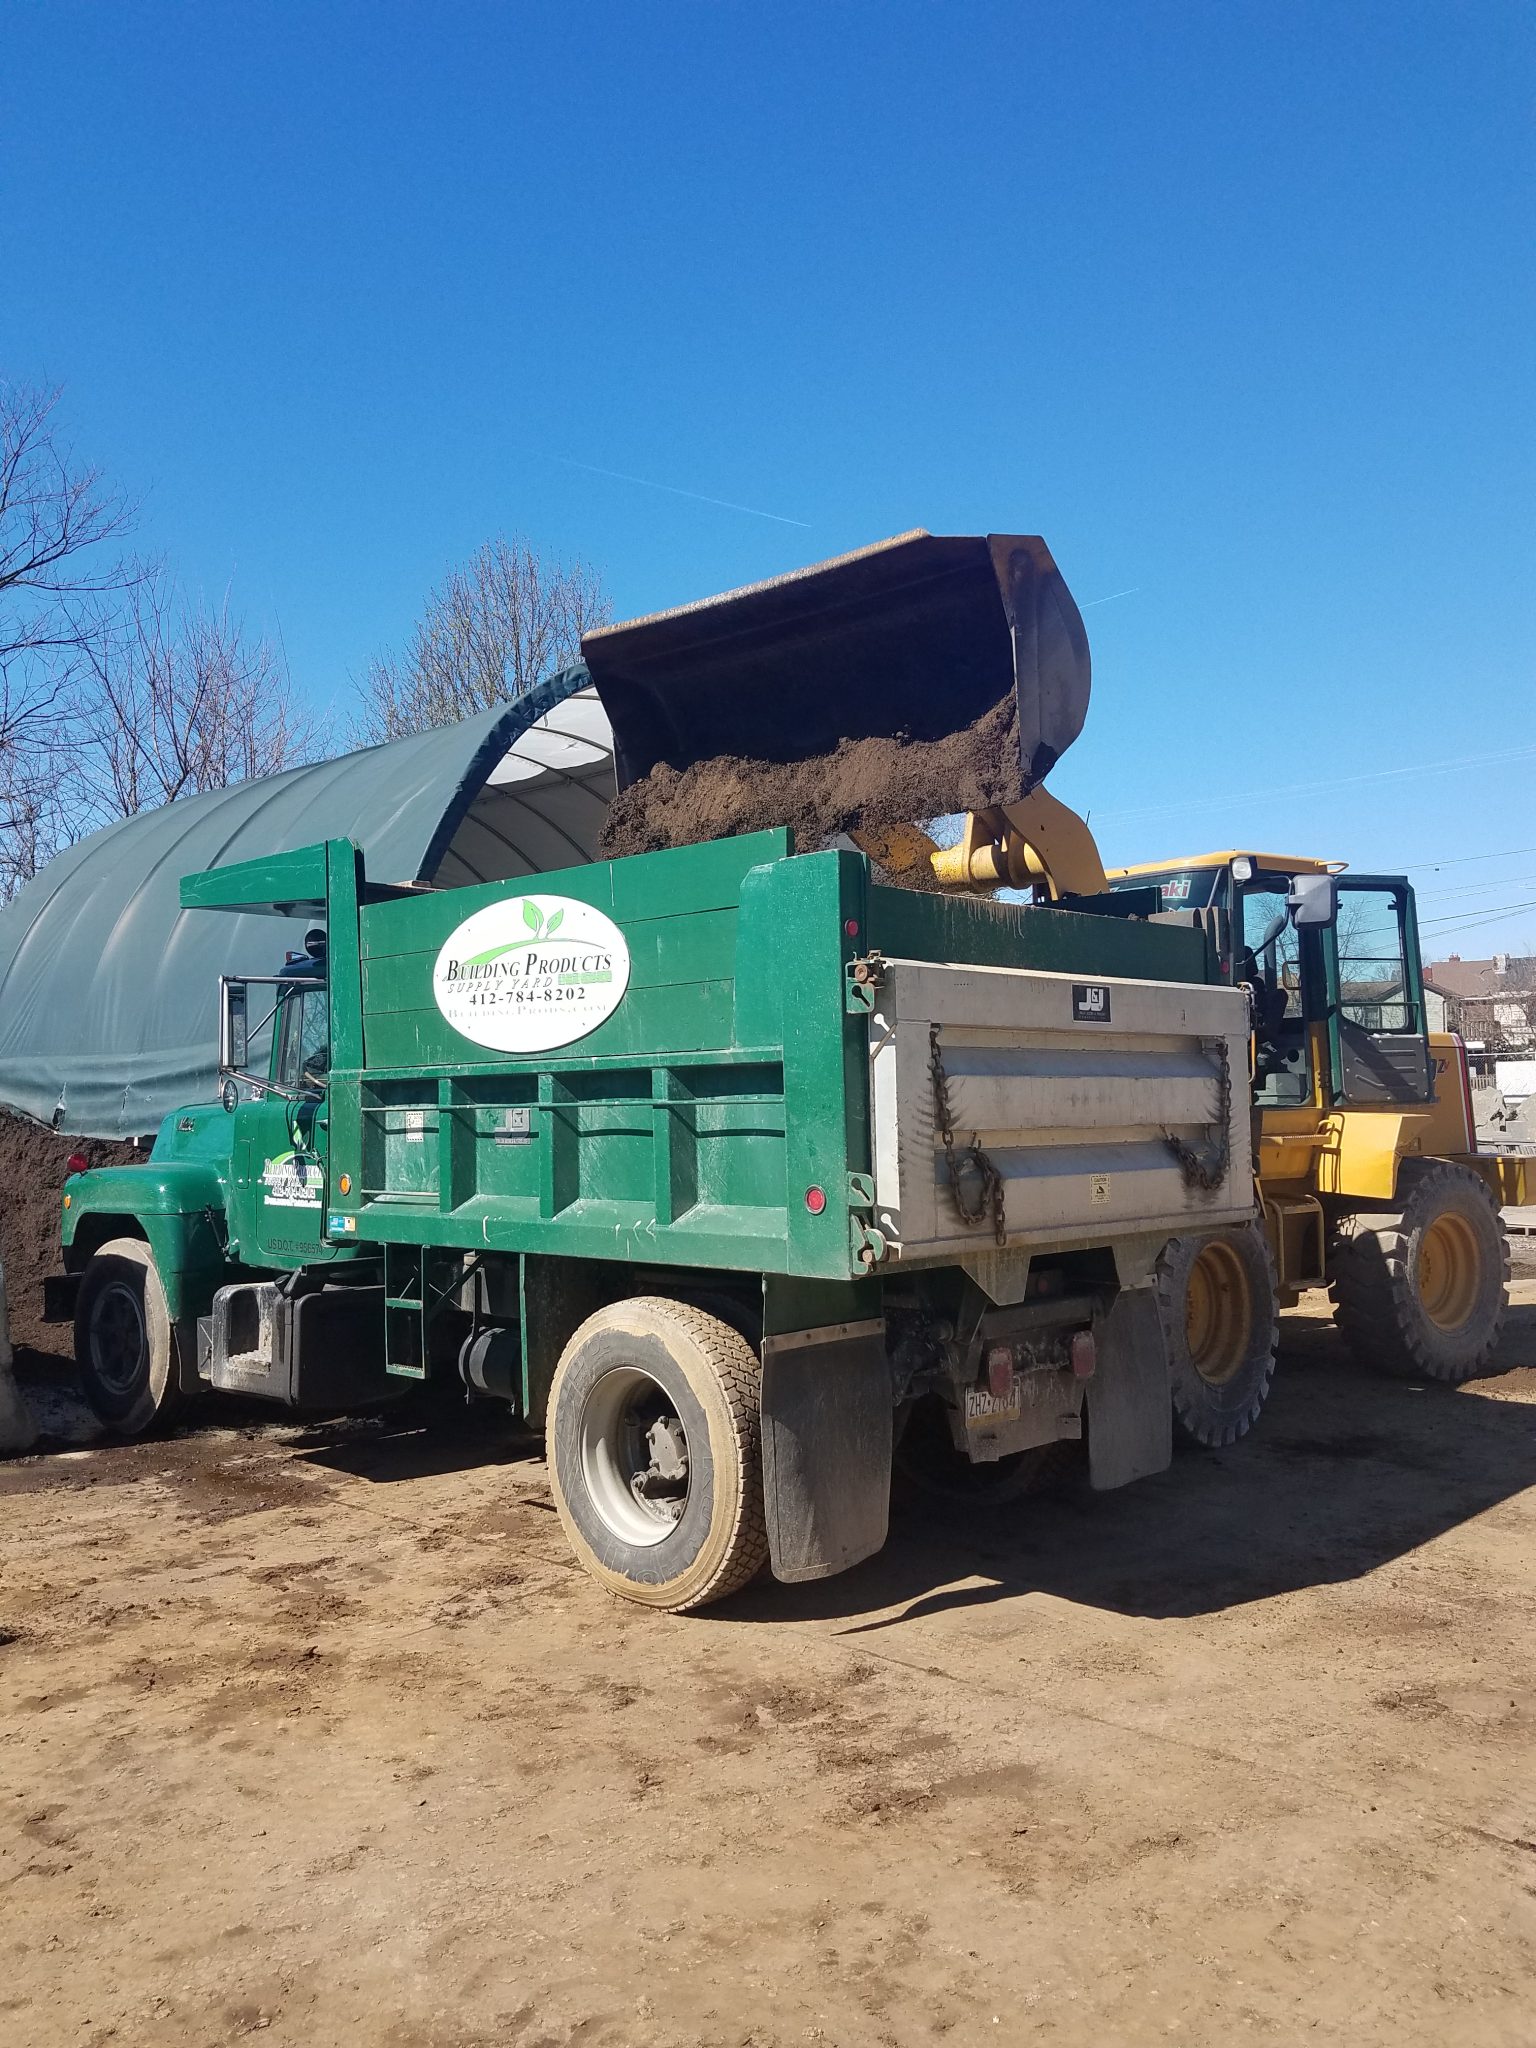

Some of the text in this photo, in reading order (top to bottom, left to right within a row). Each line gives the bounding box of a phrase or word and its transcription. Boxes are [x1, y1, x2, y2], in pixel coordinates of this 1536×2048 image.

[446, 953, 612, 981] BUILDING PRODUCTS
[447, 976, 553, 993] SUPPLY YARD
[469, 987, 586, 1005] 412-784-8202
